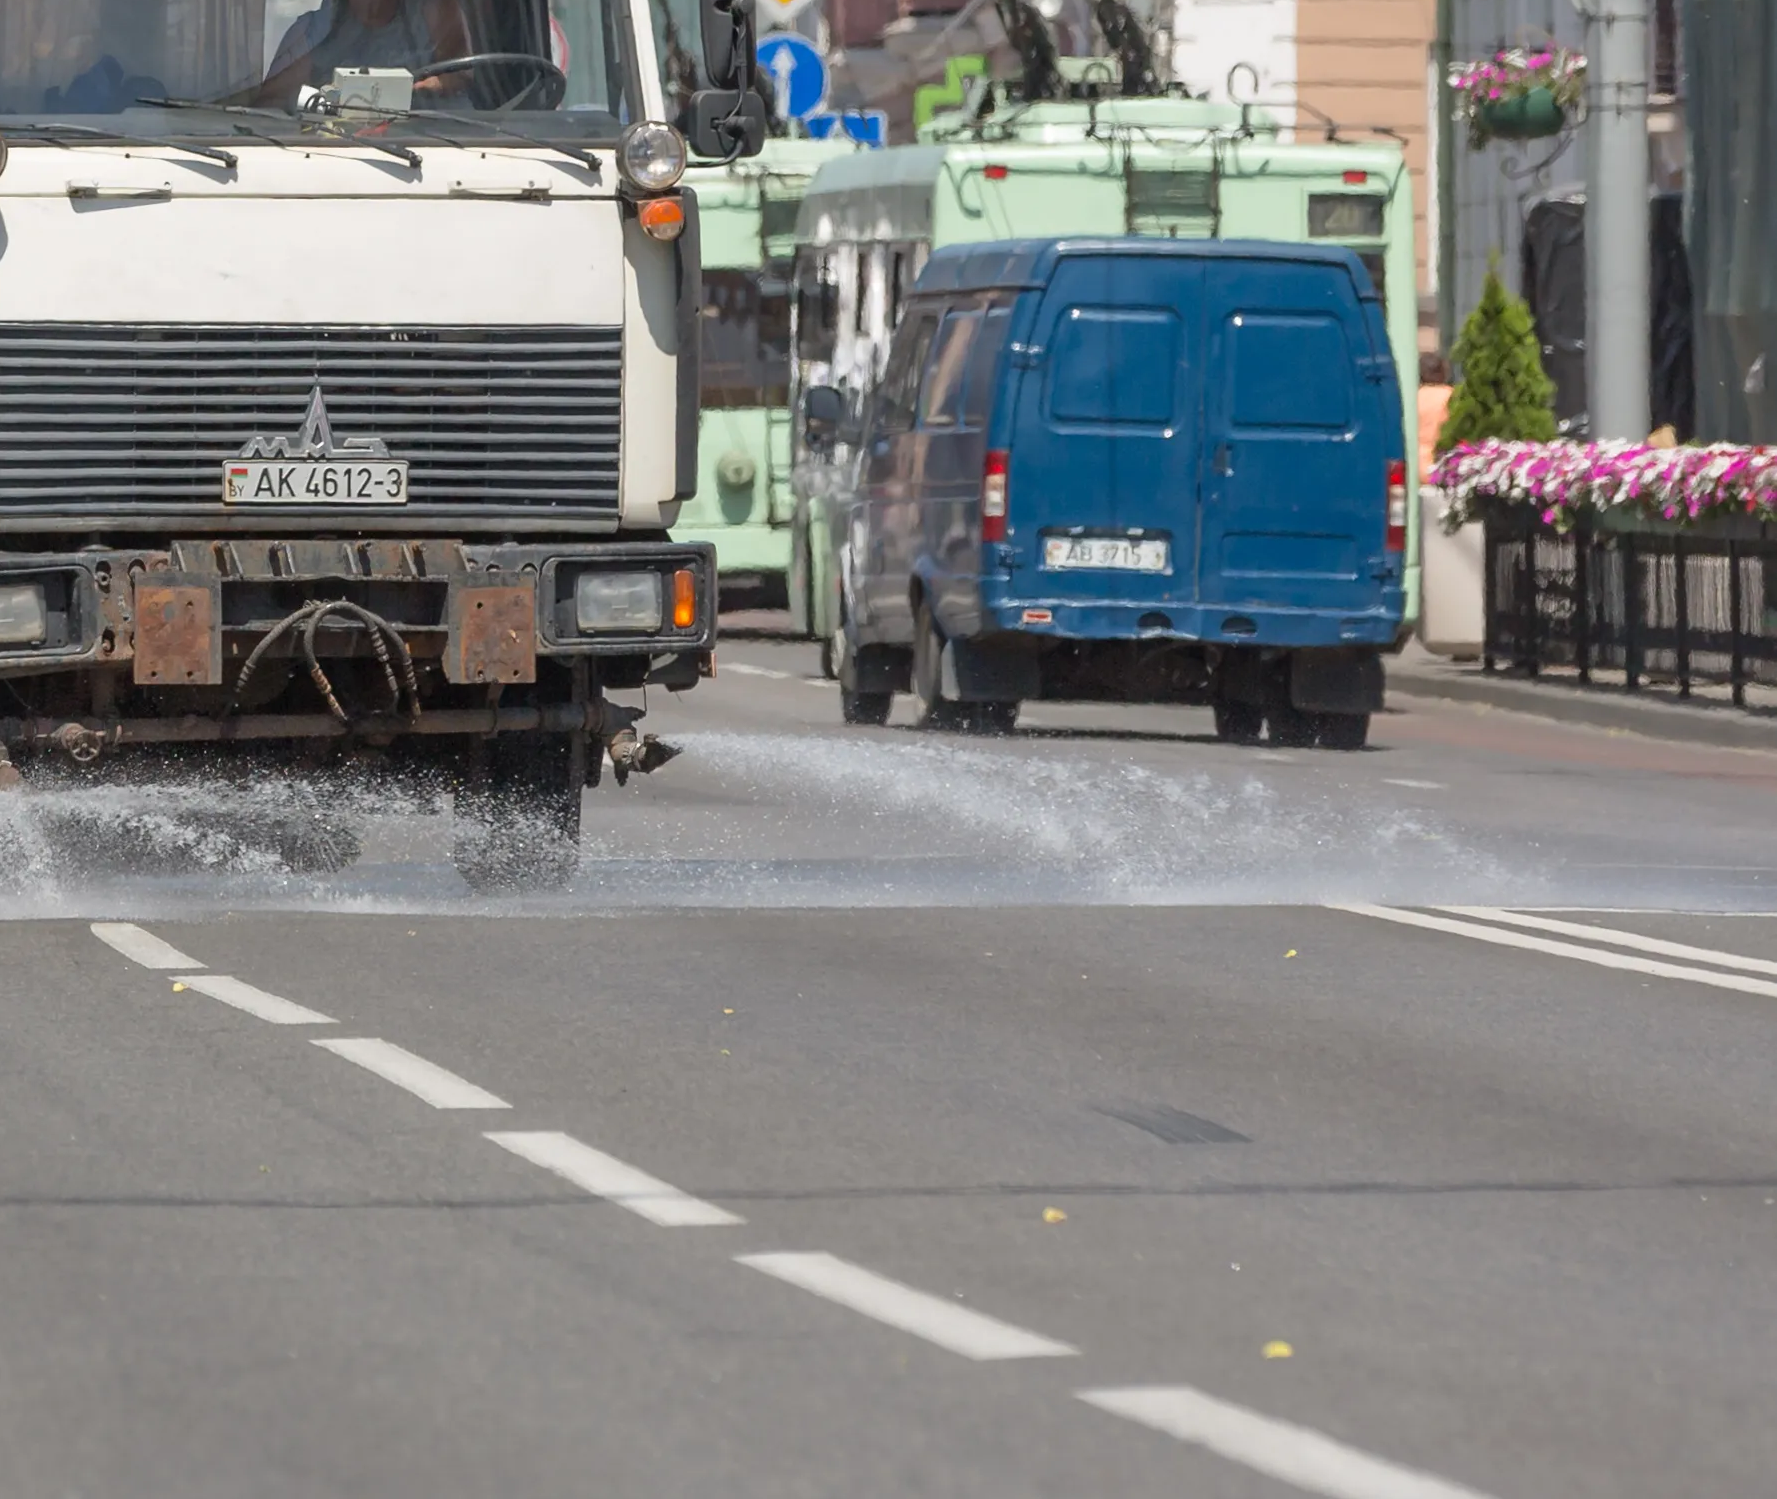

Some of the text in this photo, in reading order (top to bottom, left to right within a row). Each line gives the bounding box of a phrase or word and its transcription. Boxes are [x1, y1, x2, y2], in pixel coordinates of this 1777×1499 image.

[228, 485, 244, 497] BY
[254, 468, 402, 498] AK 4612-3
